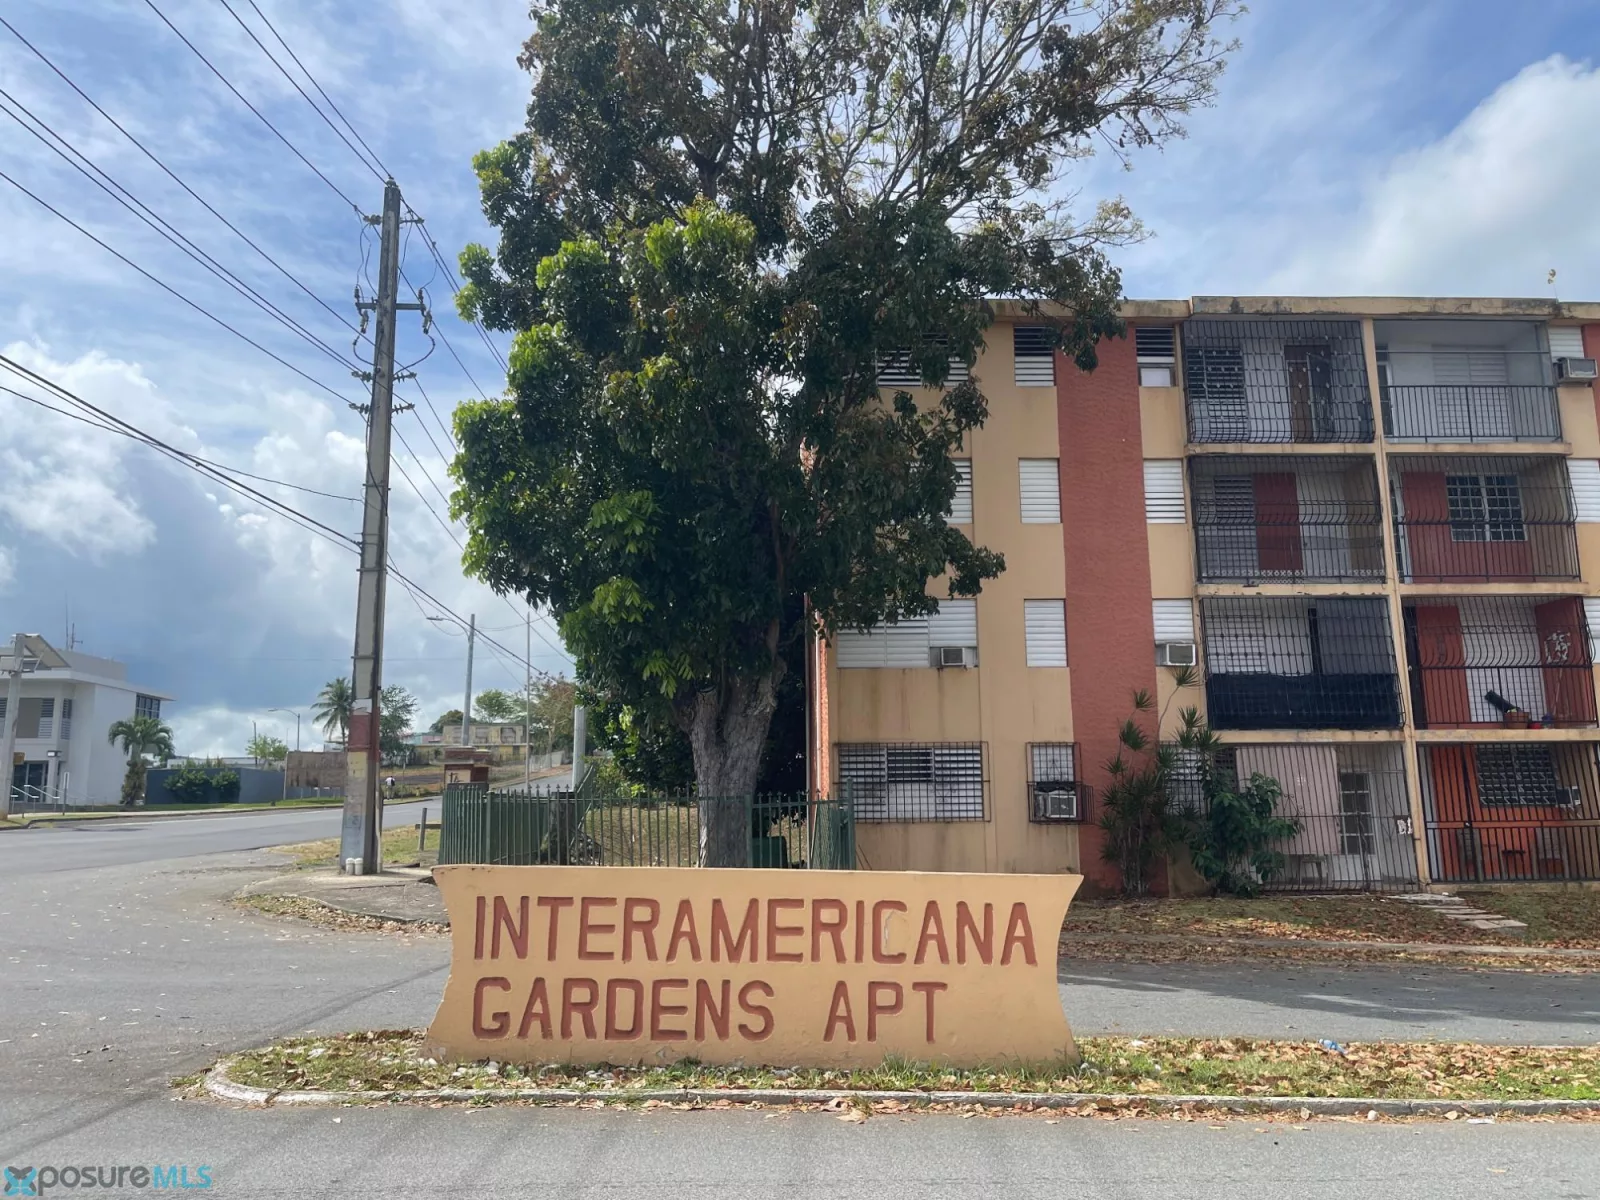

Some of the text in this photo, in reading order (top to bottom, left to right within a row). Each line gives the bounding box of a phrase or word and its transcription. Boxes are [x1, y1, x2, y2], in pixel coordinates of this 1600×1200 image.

[474, 895, 1038, 966] INTERAMERICANA
[472, 976, 948, 1044] GARDENS APT
